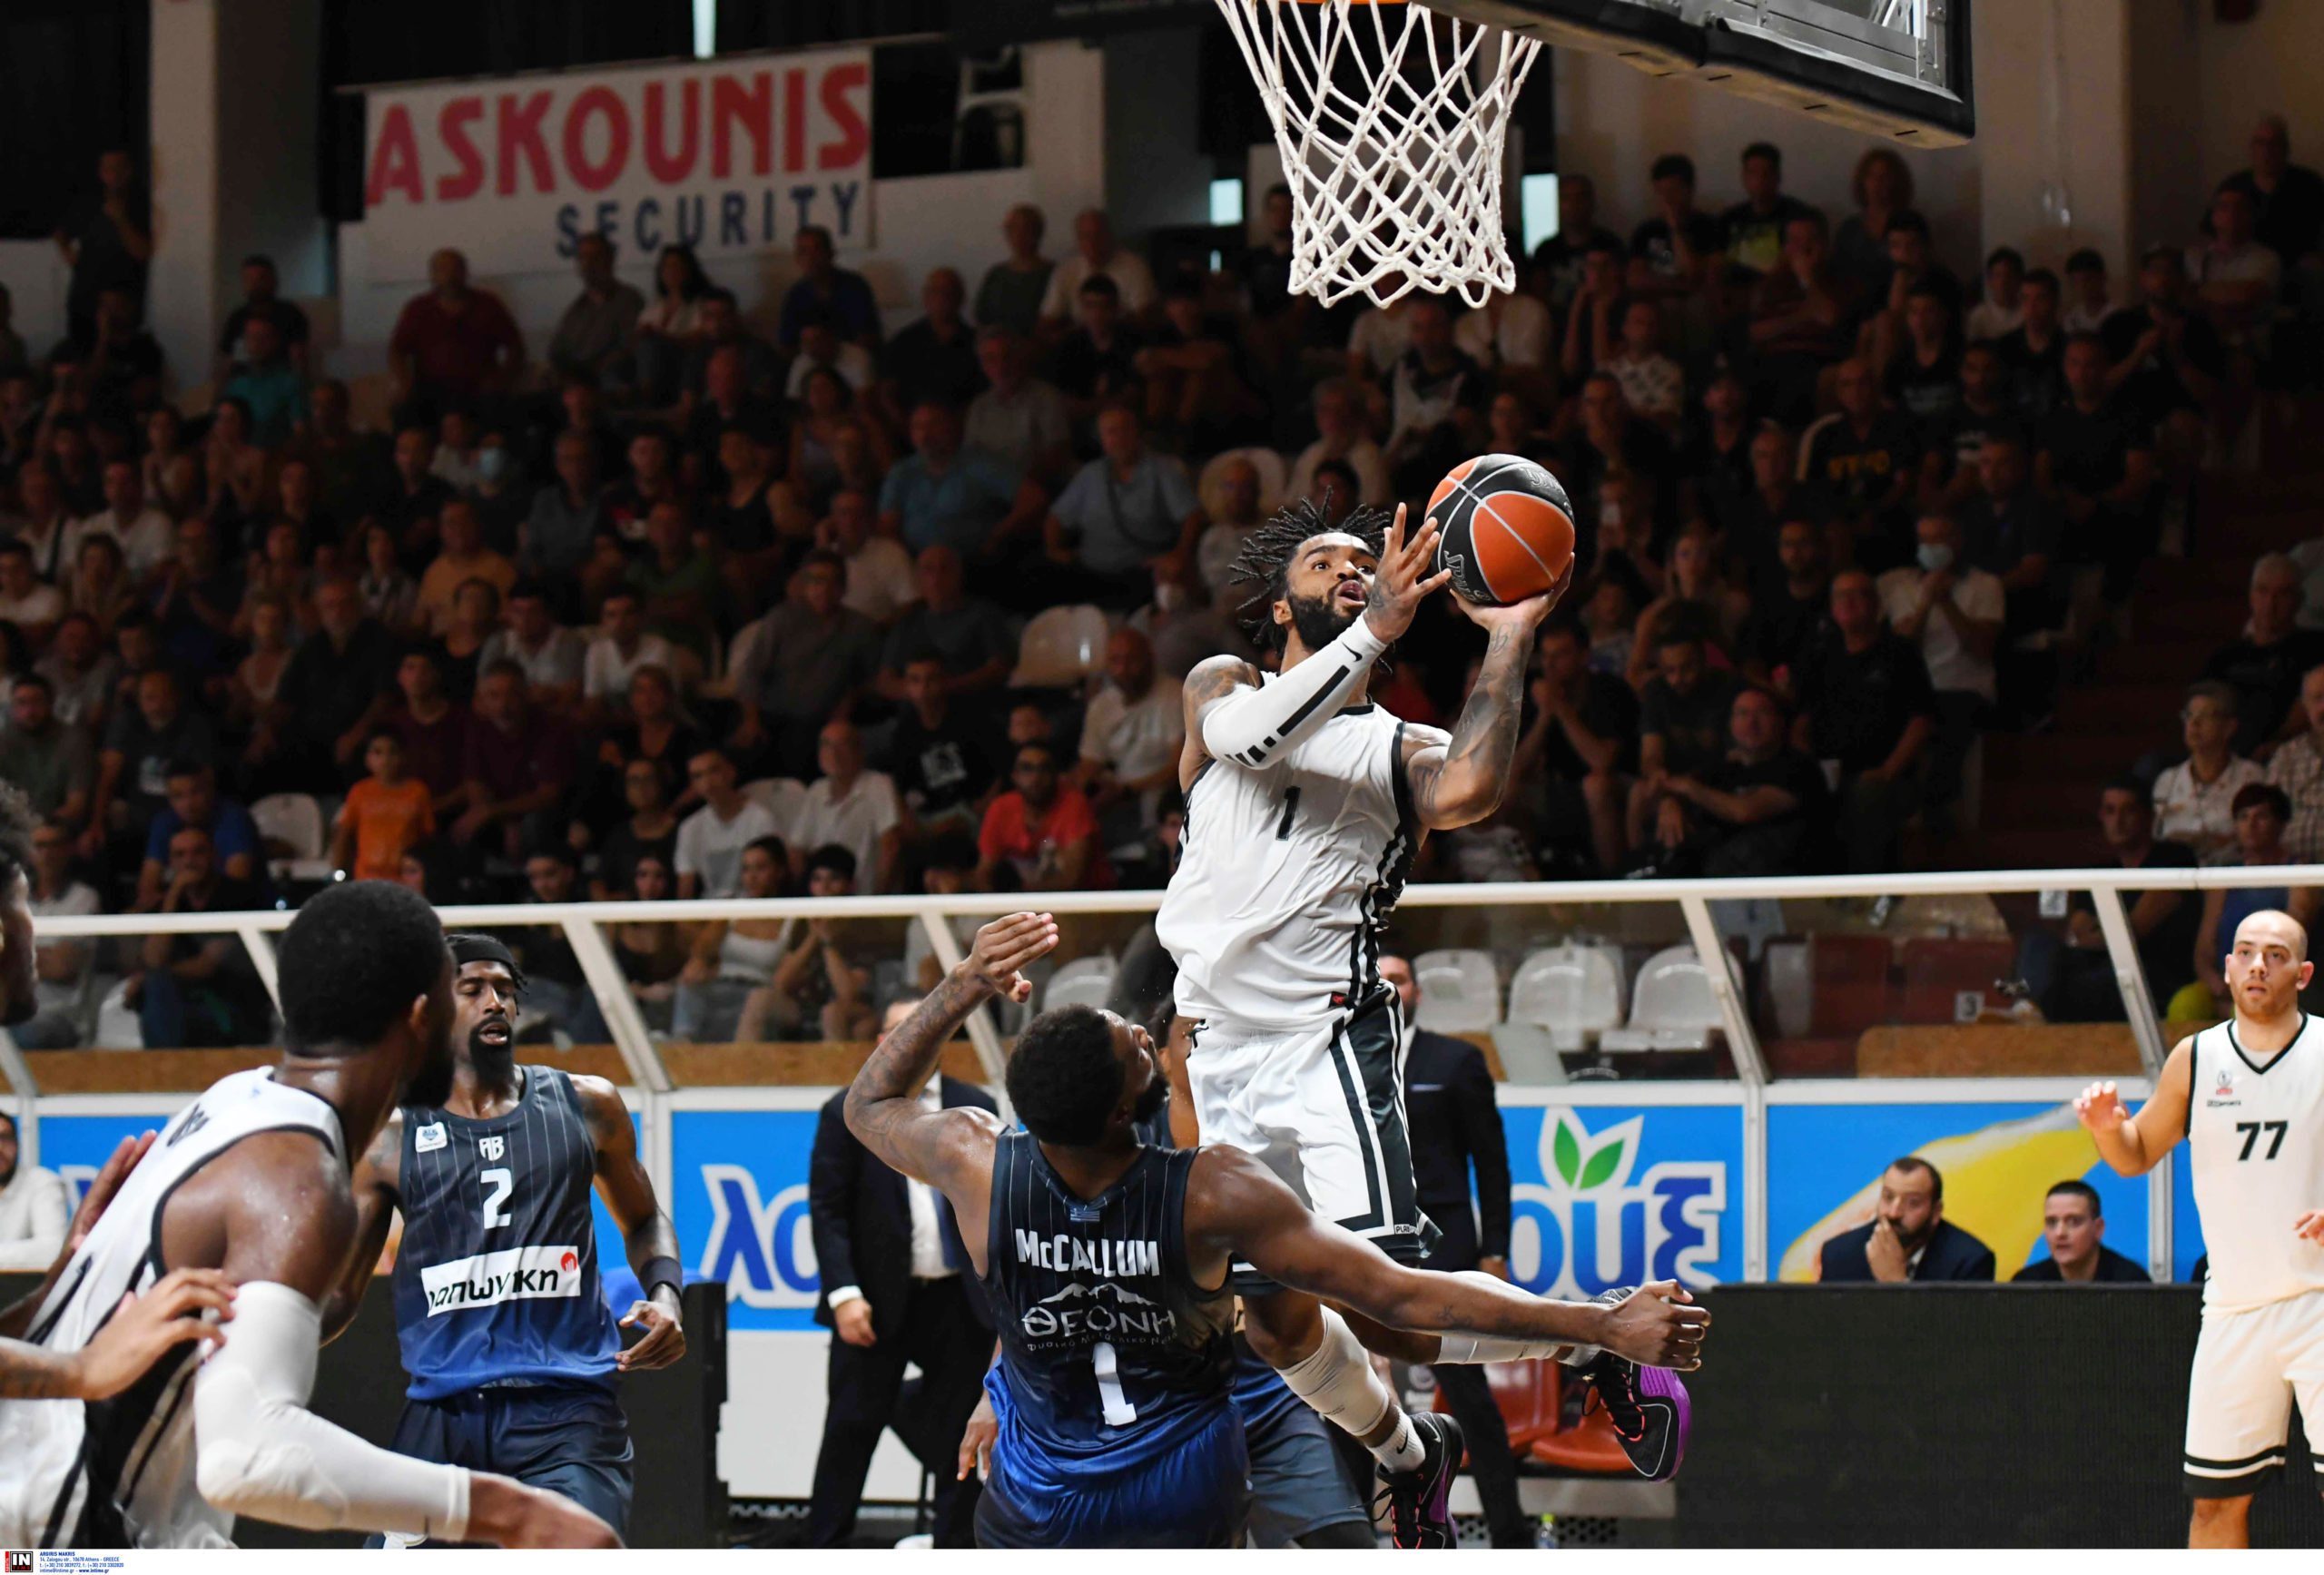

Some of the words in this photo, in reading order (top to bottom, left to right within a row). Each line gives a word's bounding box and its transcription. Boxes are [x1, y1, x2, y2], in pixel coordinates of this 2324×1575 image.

[365, 62, 870, 207] ASKOUNIS
[556, 182, 859, 260] SECURITY
[1275, 785, 1302, 842] 1
[2235, 1119, 2290, 1162] 77
[480, 1167, 513, 1230] 2
[1015, 1227, 1160, 1278] McCALLUM
[1091, 1342, 1137, 1426] 1
